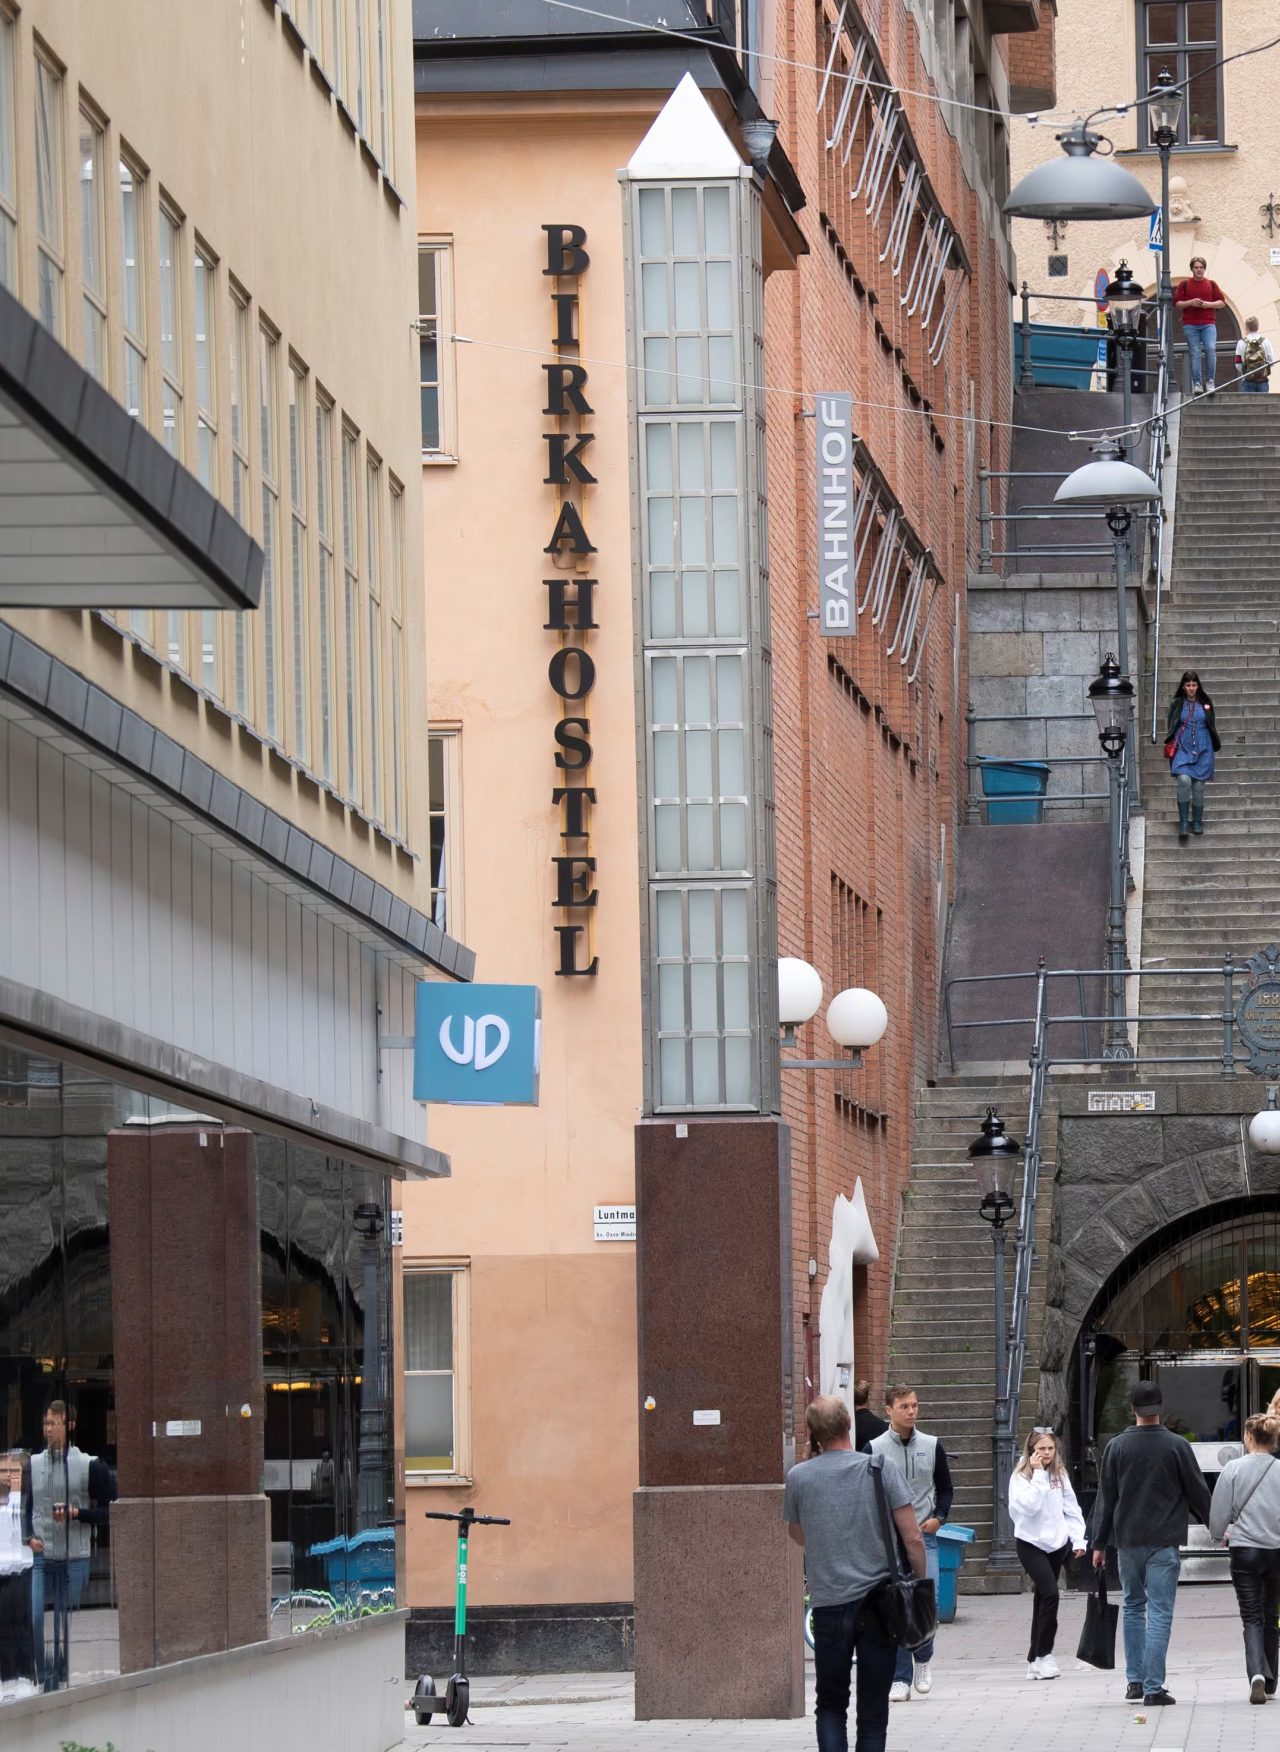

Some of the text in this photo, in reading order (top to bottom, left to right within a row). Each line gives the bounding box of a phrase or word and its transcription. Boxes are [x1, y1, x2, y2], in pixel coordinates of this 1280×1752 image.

[821, 400, 849, 628] BAHNHOF
[598, 1209, 635, 1220] Luntma
[459, 1563, 467, 1585] Bolt
